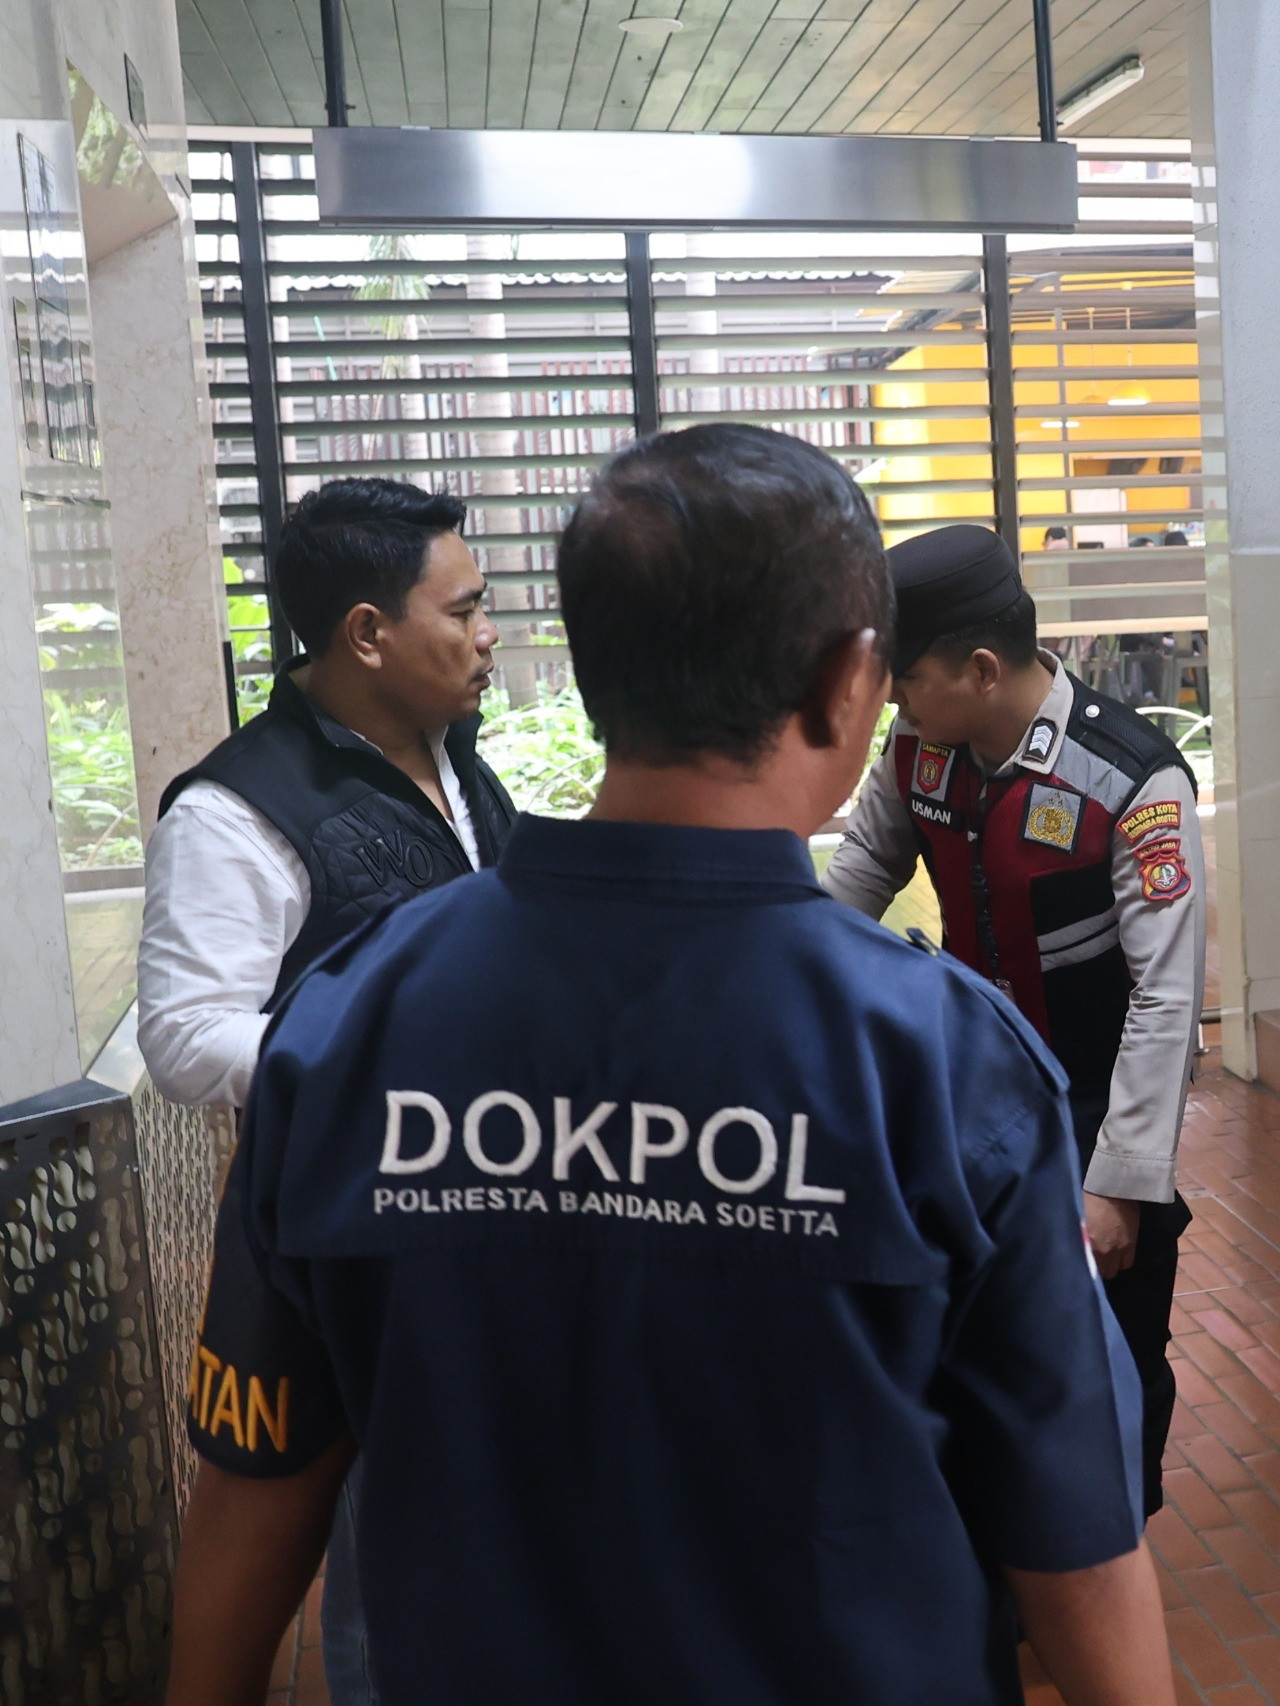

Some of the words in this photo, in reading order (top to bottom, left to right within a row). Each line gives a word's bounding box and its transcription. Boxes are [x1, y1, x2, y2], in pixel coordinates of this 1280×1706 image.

[911, 799, 951, 825] USMAN
[1121, 807, 1156, 833] POLRES
[1155, 803, 1178, 815] KOTA
[379, 1090, 846, 1203] DOKPOL
[374, 1187, 548, 1213] POLRESTA
[560, 1191, 706, 1224] BANDARA
[717, 1203, 839, 1237] SOETTA
